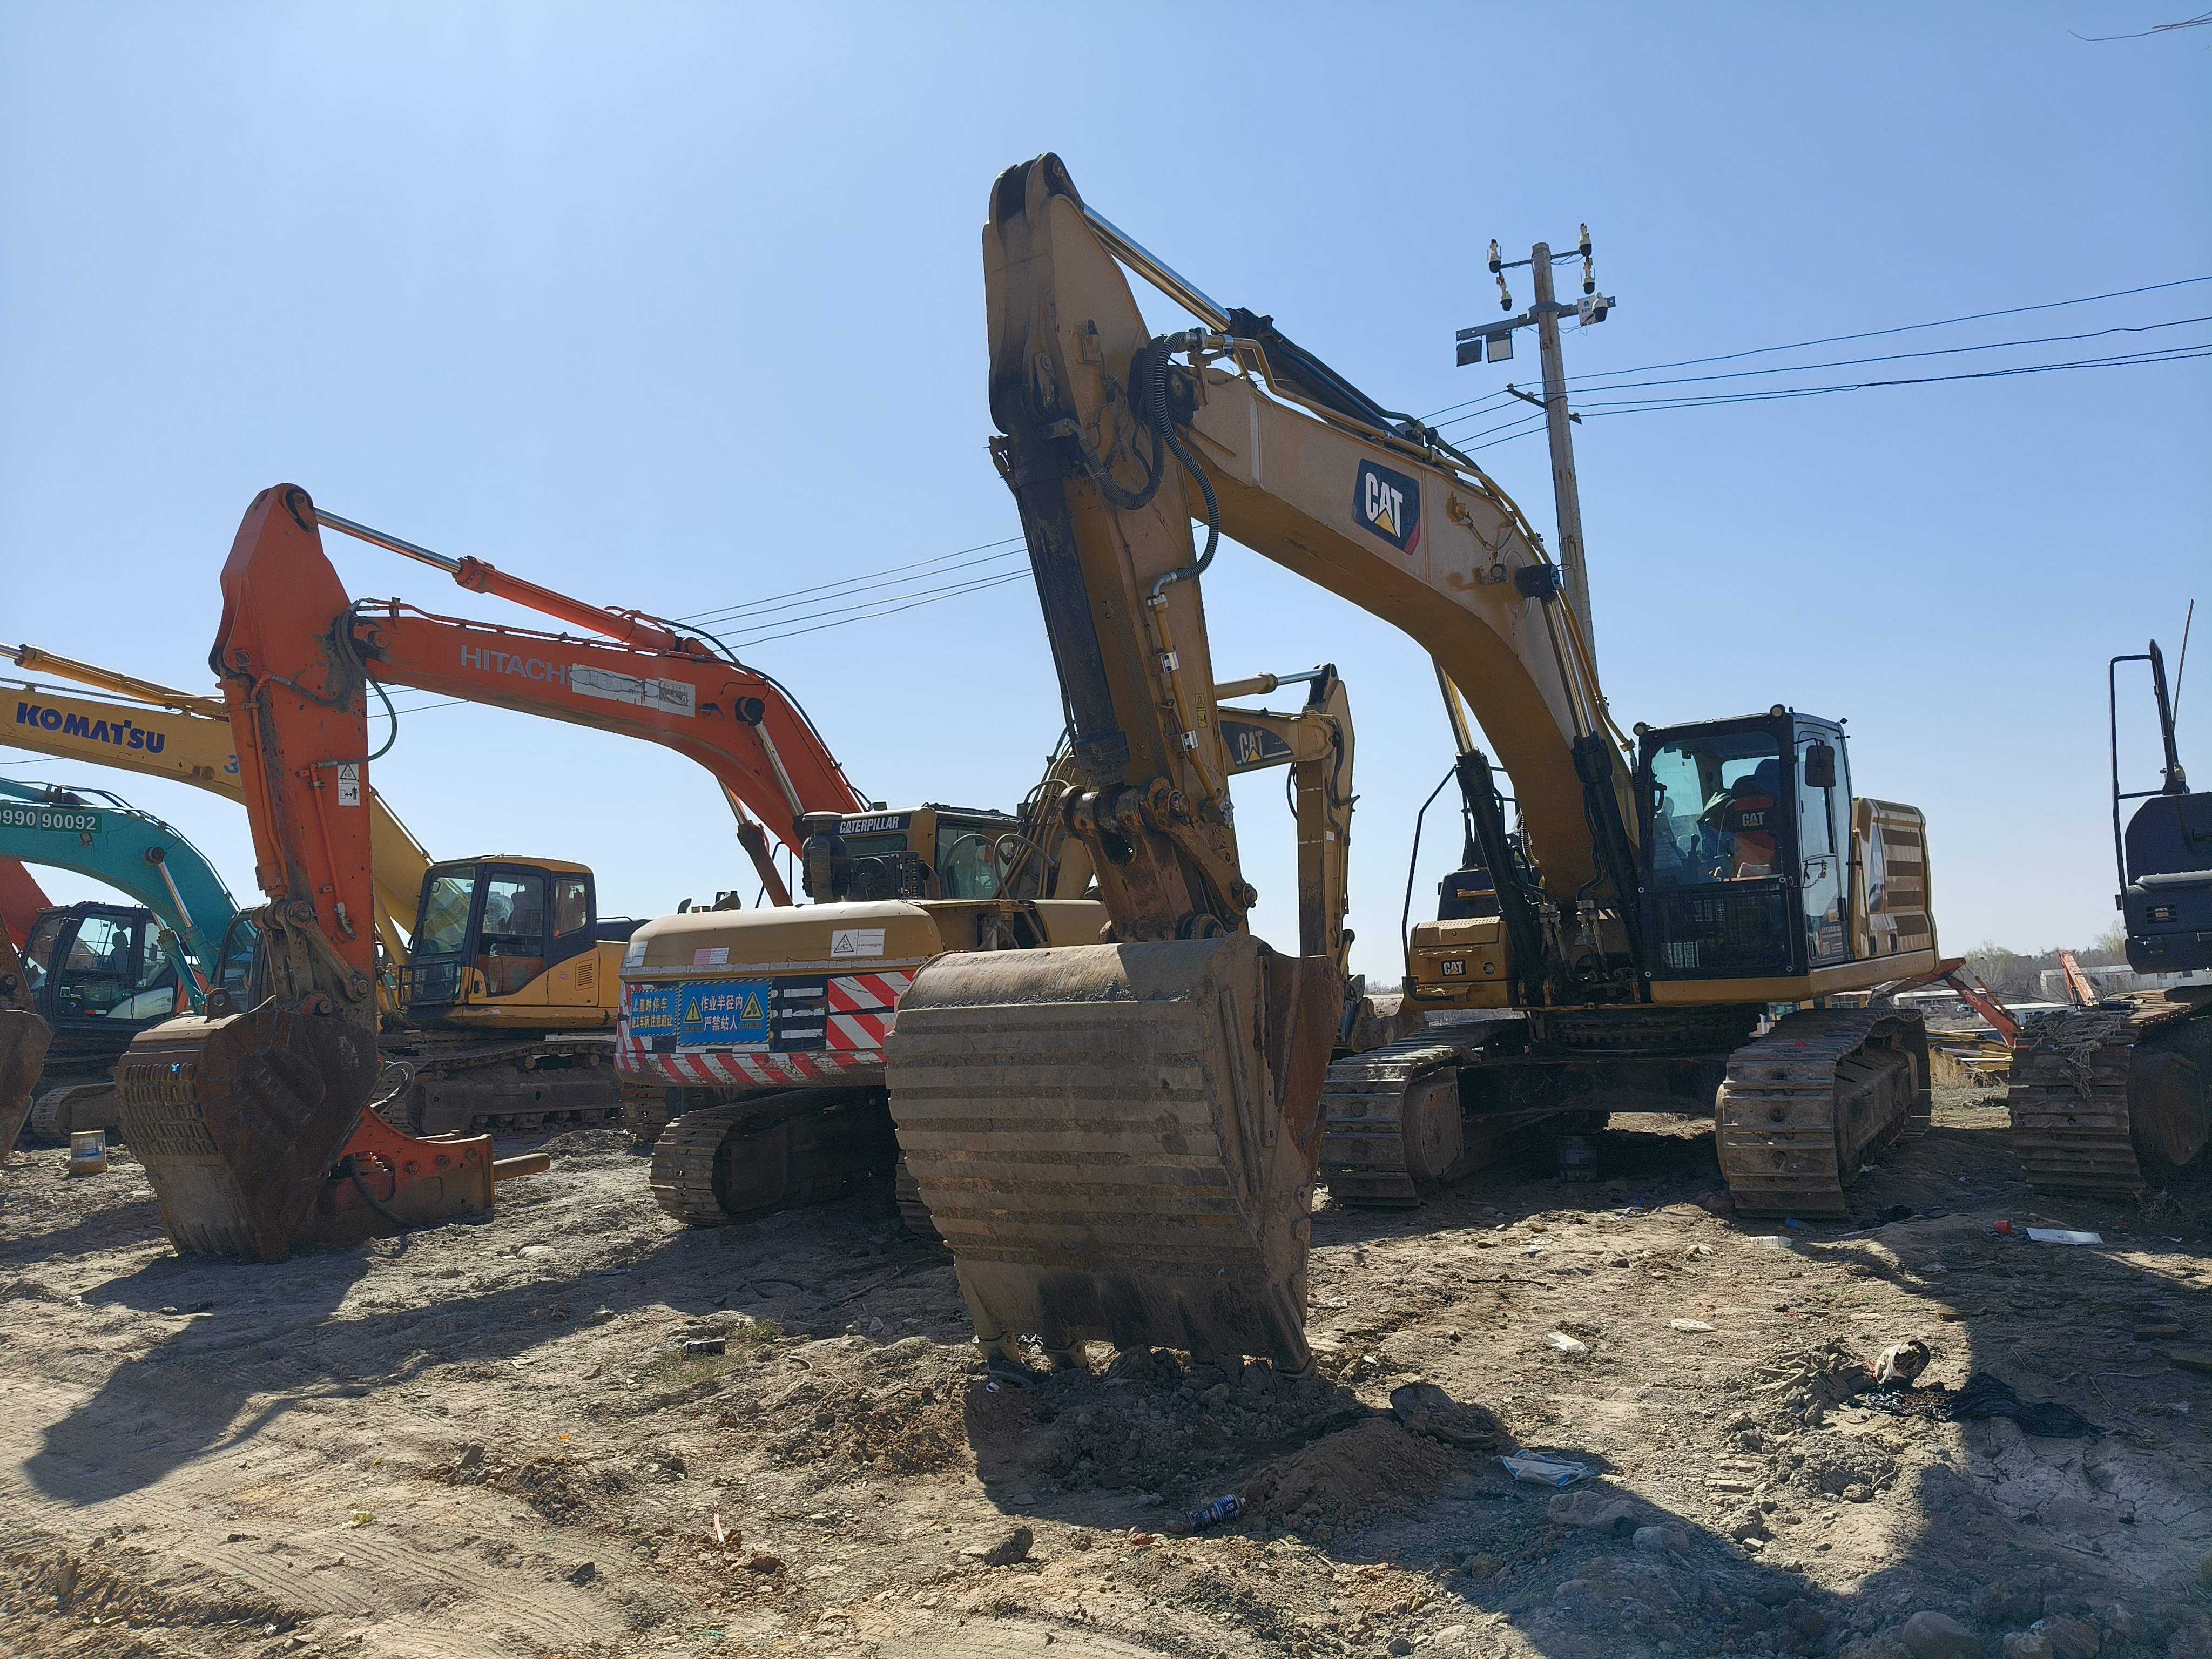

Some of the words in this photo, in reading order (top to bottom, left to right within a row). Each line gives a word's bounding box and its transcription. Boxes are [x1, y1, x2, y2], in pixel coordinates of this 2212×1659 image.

[1365, 472, 1403, 538] CAT
[16, 702, 166, 754] KOMATSU
[1239, 730, 1264, 763] CAT
[0, 810, 36, 826] 990
[42, 813, 96, 831] 90092
[839, 816, 899, 834] CATERPILLAR
[1742, 812, 1765, 827] CAT
[1444, 961, 1463, 975] CAT
[701, 994, 743, 1011] 作业半径内
[703, 1015, 738, 1031] 严禁站人
